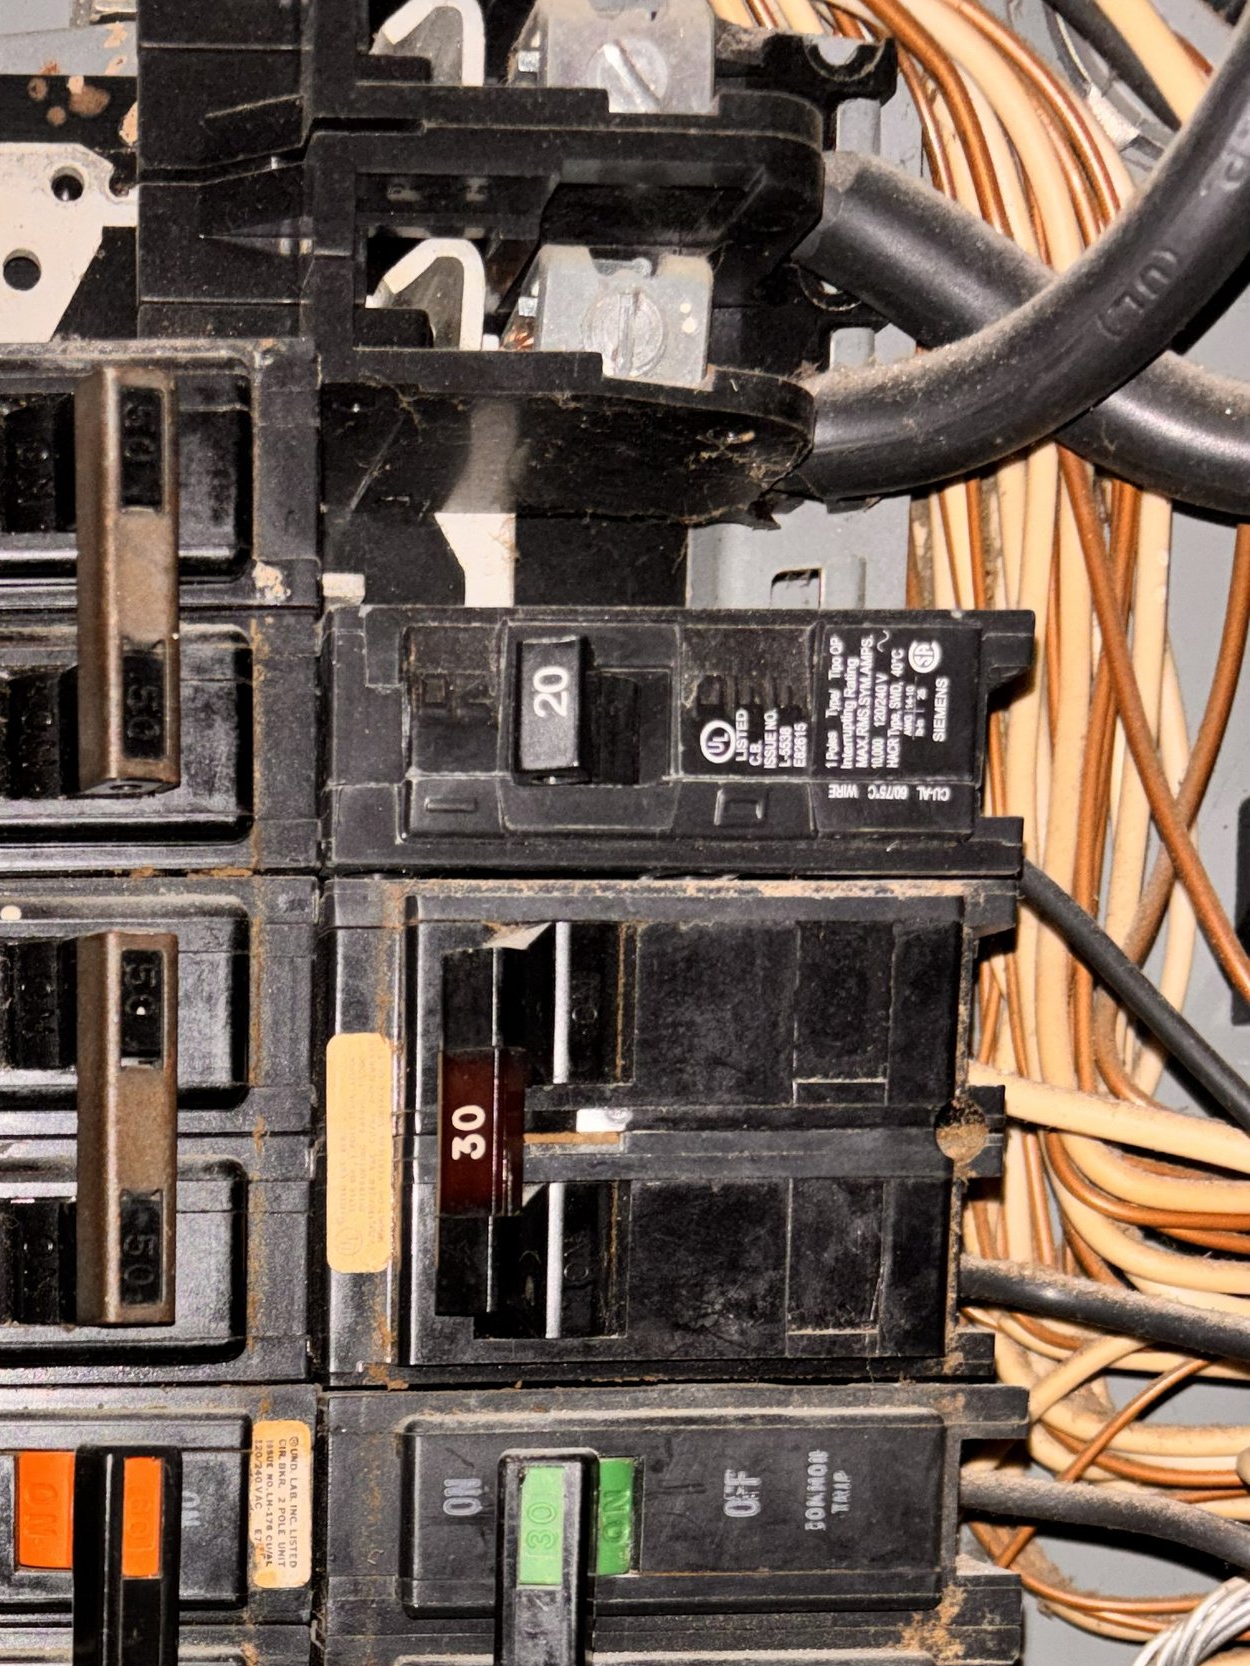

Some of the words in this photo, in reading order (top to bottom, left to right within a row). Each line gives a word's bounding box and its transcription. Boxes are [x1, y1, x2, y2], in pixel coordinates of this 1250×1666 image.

[829, 637, 843, 655] QP
[891, 649, 903, 677] 40°C
[828, 657, 842, 680] Tipo
[844, 657, 858, 697] Rating
[876, 673, 887, 683] V
[532, 665, 569, 718] 20
[874, 686, 887, 727] 120/240
[905, 685, 915, 709] 14-10
[933, 678, 948, 742] SIEMENS
[126, 685, 161, 740] 50
[765, 709, 777, 730] NO.
[904, 714, 913, 736] AWG
[736, 708, 748, 761] LISTED
[750, 740, 762, 765] C.B.
[764, 732, 776, 769] ISSUE
[779, 726, 792, 767] L-5538
[794, 722, 806, 767] E82615
[826, 731, 838, 760] Poles
[841, 702, 857, 769] Interrupting
[872, 739, 884, 768] 10,000
[887, 738, 900, 768] HACR
[828, 784, 859, 798] WIRE
[916, 786, 950, 801] CU-AL
[451, 1104, 486, 1160] 30
[123, 1234, 158, 1285] 50
[254, 1439, 262, 1483] 120/240
[254, 1487, 262, 1510] VAC
[443, 1478, 482, 1516] ON
[723, 1468, 761, 1517] OFF
[804, 1449, 828, 1531] COMMON
[830, 1470, 851, 1514] TRIP
[278, 1507, 286, 1535] POLE
[525, 1502, 557, 1549] 30
[603, 1489, 630, 1543] ON
[265, 1534, 273, 1567] CU/AL
[289, 1529, 297, 1568] LISTED
